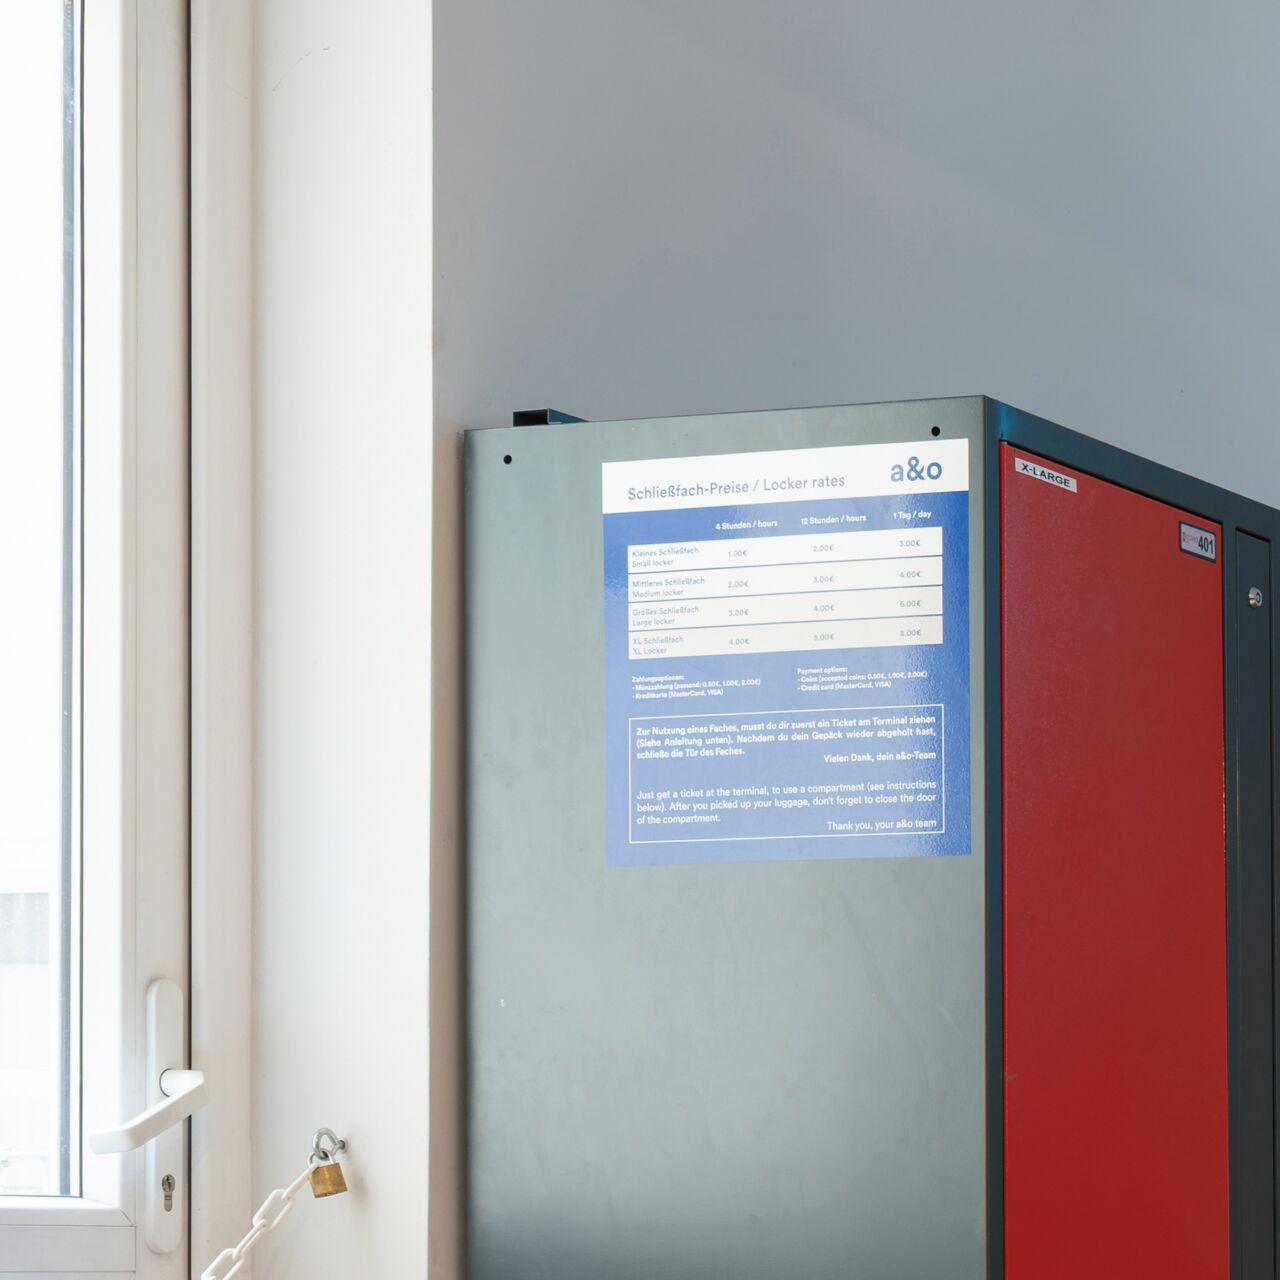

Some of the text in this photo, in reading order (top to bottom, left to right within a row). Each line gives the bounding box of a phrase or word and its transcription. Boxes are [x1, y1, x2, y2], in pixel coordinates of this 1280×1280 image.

[891, 456, 942, 482] a&o
[1021, 463, 1071, 488] X-LARGE
[628, 476, 845, 500] Schließfach-Preise / Locker rates
[809, 516, 839, 524] Stunden
[846, 514, 867, 522] hours
[899, 512, 911, 520] Tag
[918, 510, 932, 519] day
[722, 522, 751, 530] Stunden
[758, 520, 778, 528] hours
[658, 547, 699, 556] Schließfach
[1198, 535, 1214, 554] 401
[664, 577, 705, 586] Schließfach
[632, 606, 699, 616] Großes Schließfach
[636, 715, 936, 736] Zur Nutzung eines Faches, musst du dir zuerst ein Ticket am Terminal ziehen
[636, 727, 936, 749] (Siehe Anleitung unten). Nachdem du dein Gepäck wieder abgeholt hast,
[636, 746, 746, 760] schließe die Tür des Faches.
[823, 751, 936, 763] Vielen Dank, dein a&o-Team
[636, 790, 654, 800] Just
[656, 790, 671, 801] get
[679, 788, 703, 798] ticket
[705, 788, 714, 797] at
[716, 787, 730, 796] the
[732, 786, 770, 796] terminal,
[771, 786, 781, 795] to
[783, 786, 798, 795] use
[807, 782, 864, 795] compartment
[866, 782, 885, 792] (see
[887, 780, 936, 791] instructions
[636, 792, 936, 813] below). After you picked up your luggage, don't forget to close the door
[636, 813, 721, 825] of the compartment.
[827, 818, 936, 832] Thank you, your a&o team
